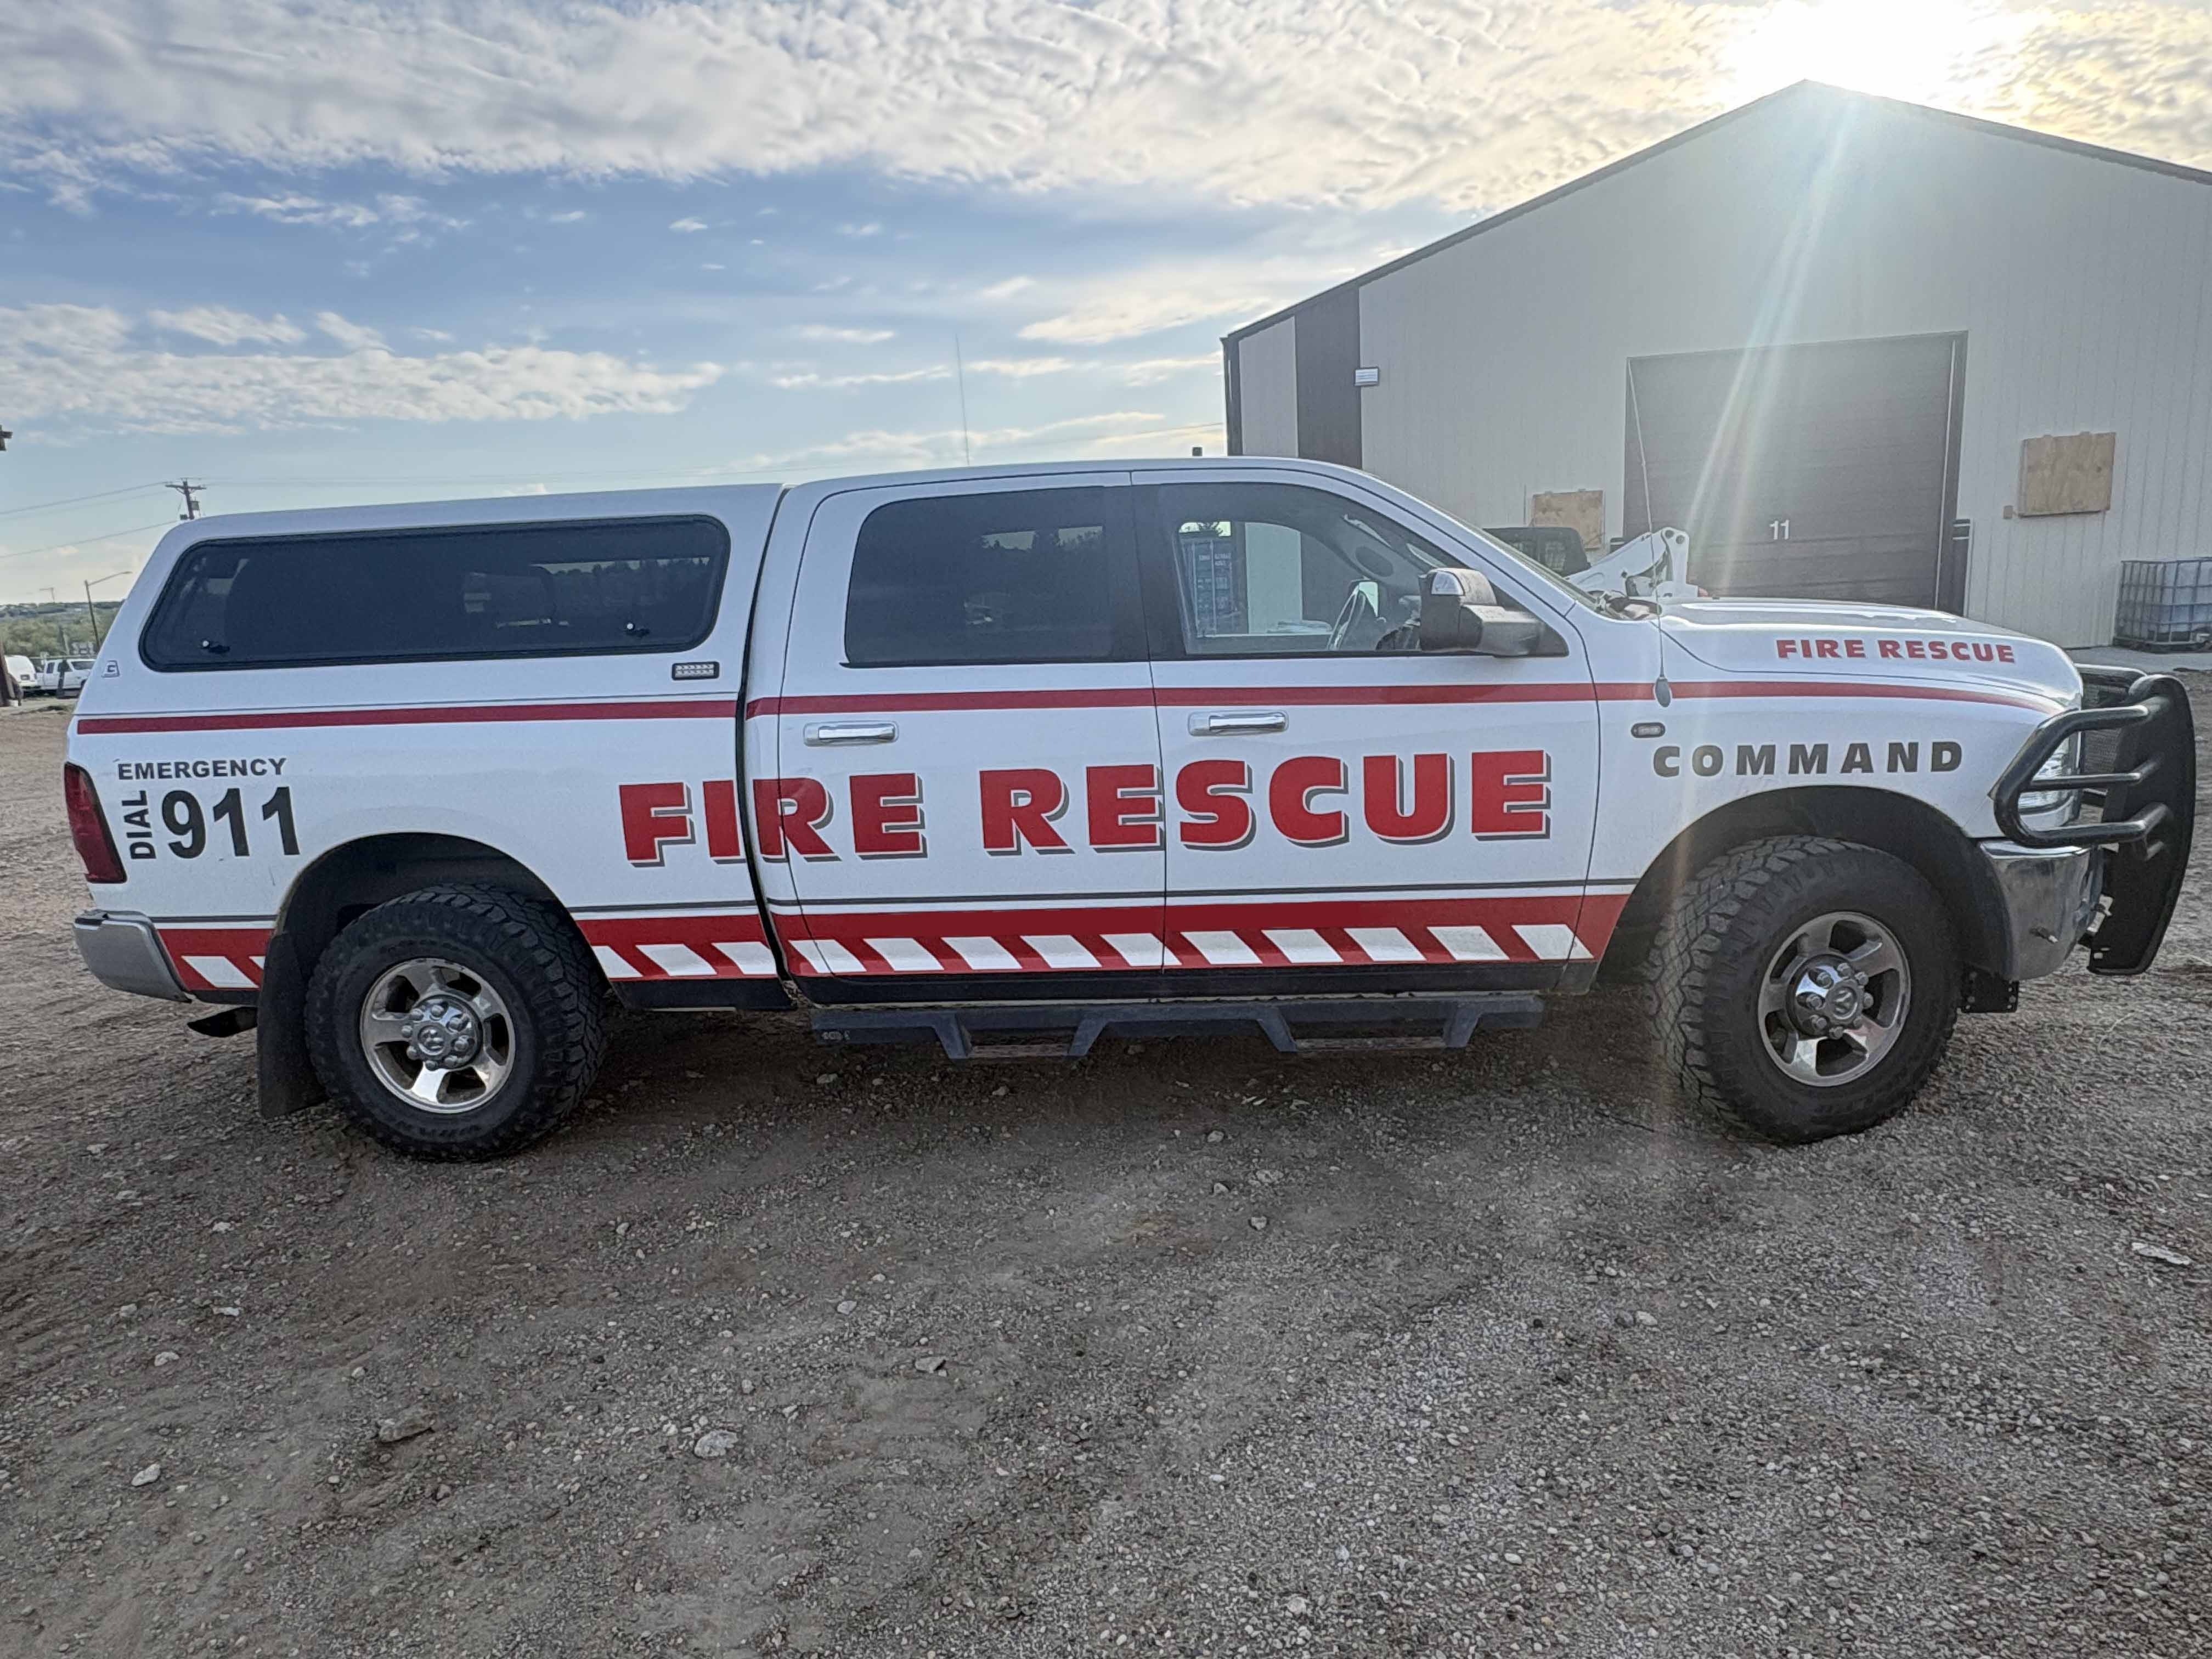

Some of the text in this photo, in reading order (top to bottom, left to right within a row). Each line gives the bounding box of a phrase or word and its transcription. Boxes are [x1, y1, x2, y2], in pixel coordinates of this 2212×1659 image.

[1769, 519, 1790, 540] 11
[1776, 639, 2015, 663] FIRE RESCUE
[117, 758, 286, 780] EMERGENCY
[1653, 741, 1962, 777] COMMAND
[122, 790, 156, 859] DIAL
[161, 786, 300, 859] 911
[619, 749, 1551, 867] FIRE RESCUE
